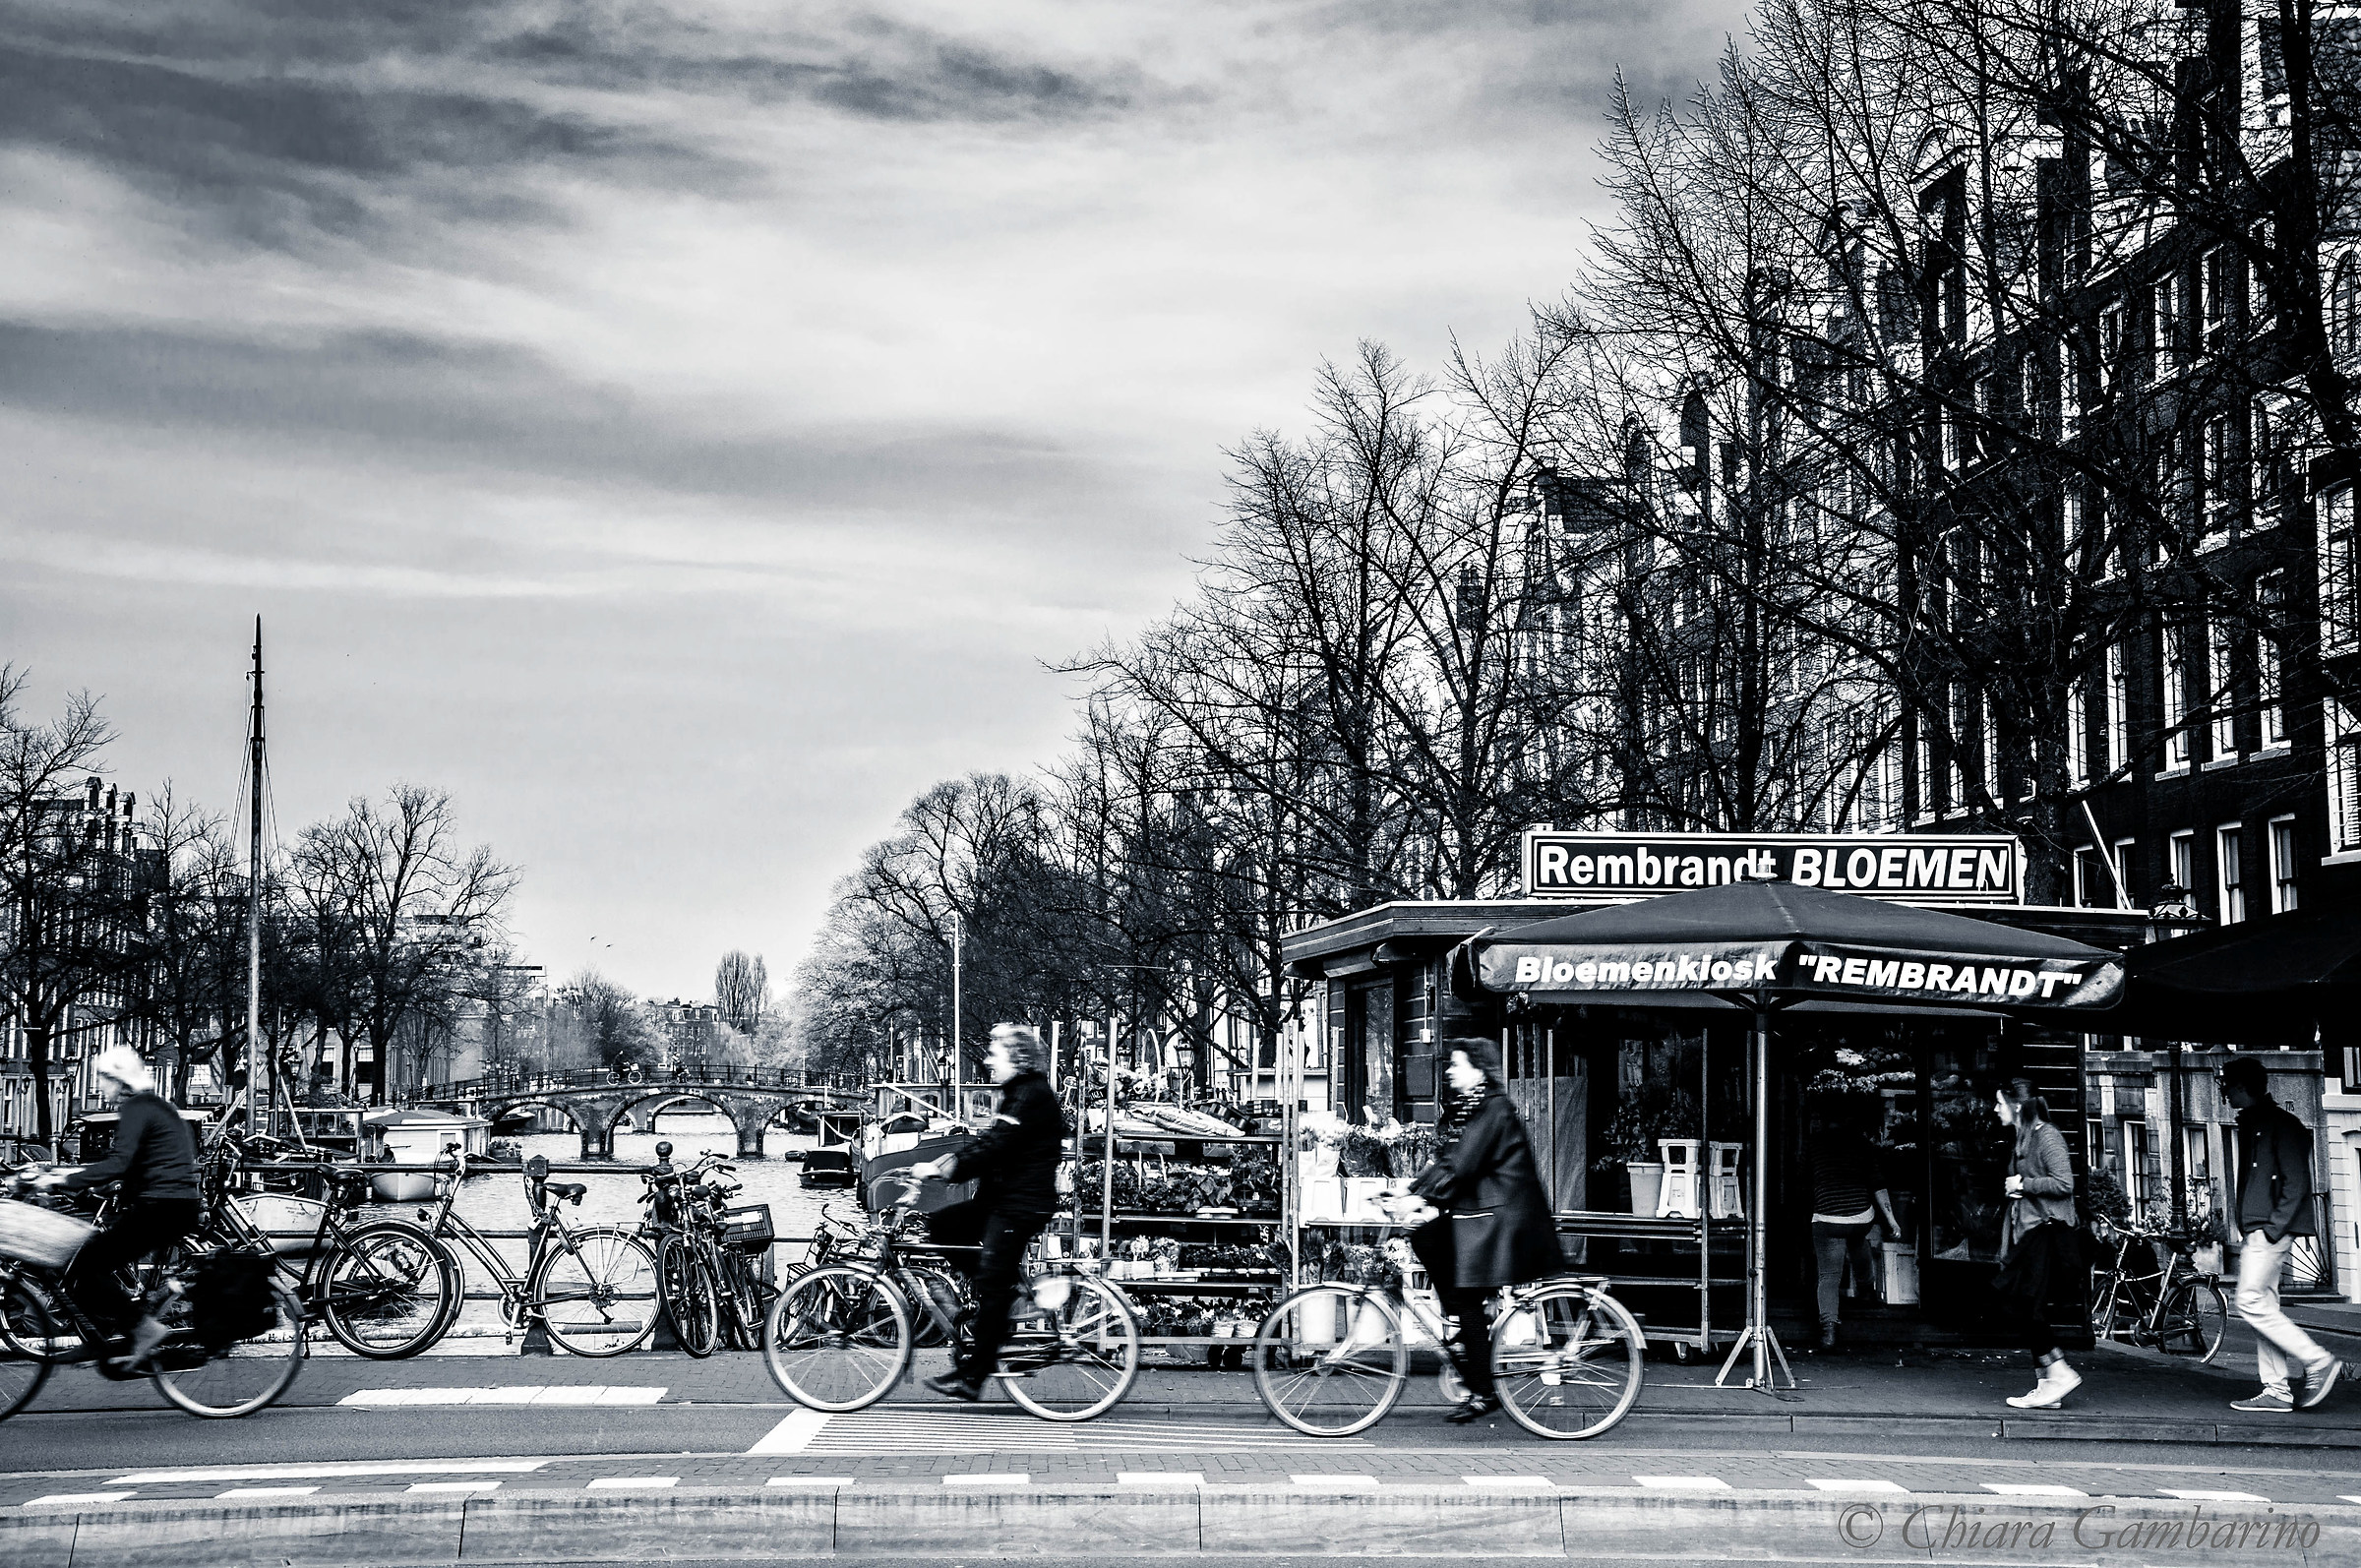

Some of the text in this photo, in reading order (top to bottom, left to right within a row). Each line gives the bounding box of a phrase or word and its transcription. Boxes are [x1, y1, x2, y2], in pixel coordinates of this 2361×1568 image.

[1540, 846, 2009, 889] Rembrandt BLOEMEN
[1515, 952, 2084, 999] Bloemenkiosk "REMBRANDT"
